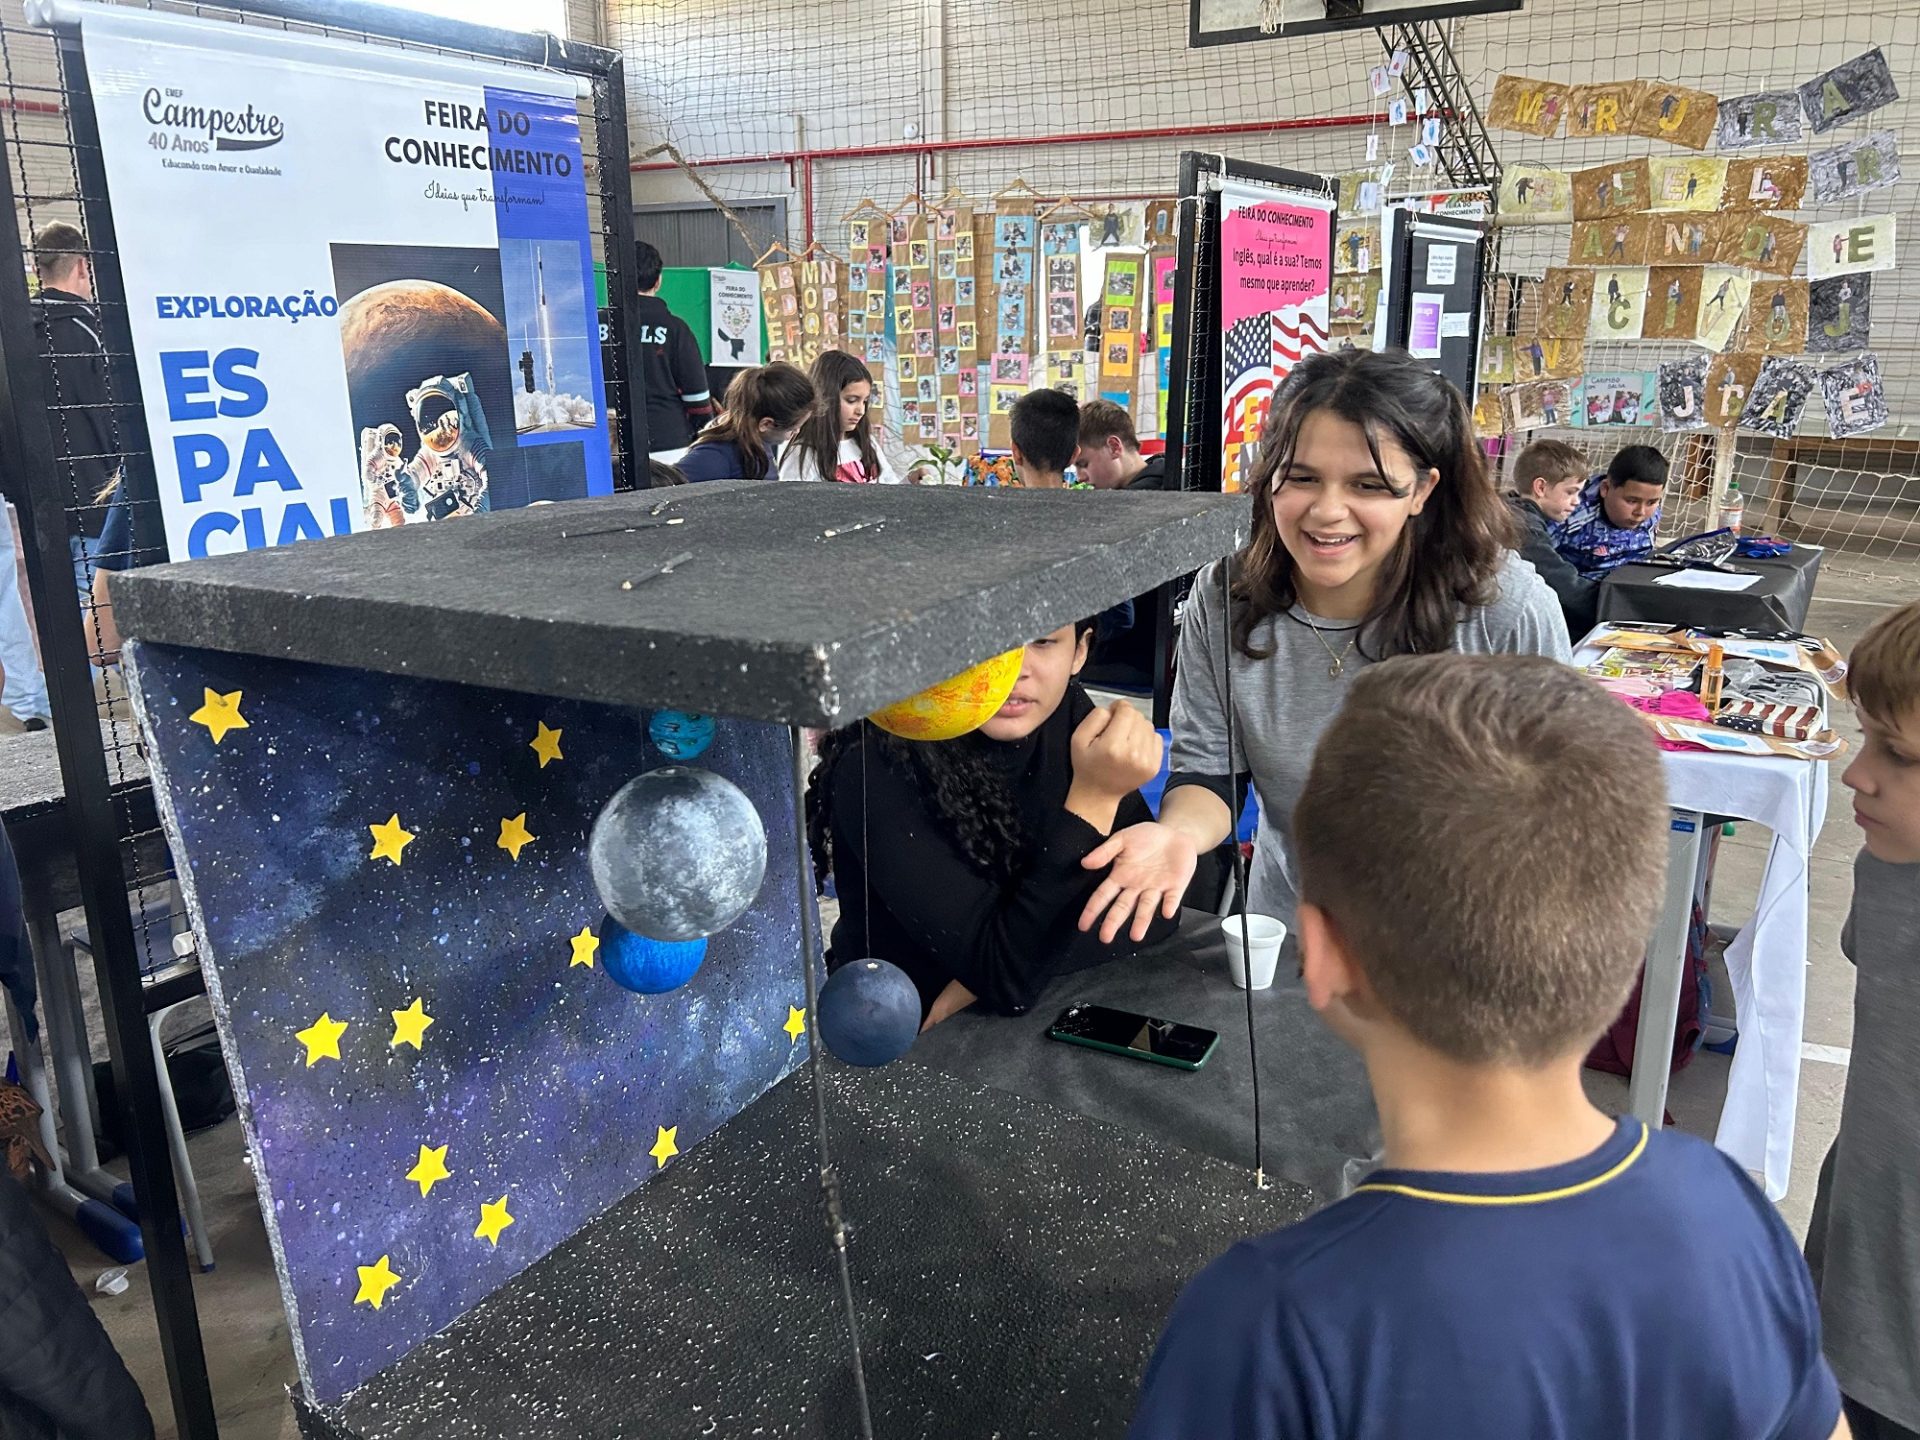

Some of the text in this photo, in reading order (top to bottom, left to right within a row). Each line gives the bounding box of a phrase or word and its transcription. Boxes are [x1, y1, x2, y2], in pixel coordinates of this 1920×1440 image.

[165, 88, 183, 98] EMEF
[1514, 79, 1851, 138] M R J R A
[143, 87, 284, 141] Campestre
[424, 99, 531, 137] FEIRA DO
[148, 131, 209, 154] 40 Anos
[385, 136, 572, 178] CONHECIMENTO
[162, 158, 200, 171] Educando
[201, 163, 217, 172] com
[218, 163, 237, 174] Amor
[239, 166, 244, 174] e
[1660, 165, 1688, 201] E
[1748, 167, 1775, 200] L
[1854, 147, 1883, 186] R
[424, 180, 545, 213] Ideias que transformam!
[1238, 205, 1314, 229] FEIRA DO CONHECIMENTO
[1233, 247, 1322, 270] Inglês, qual é a sua? Temos
[1581, 225, 1604, 258] A
[1663, 223, 1691, 257] N
[1847, 225, 1876, 264] E
[762, 266, 795, 292] A B
[802, 260, 837, 285] M N
[1240, 276, 1315, 295] mesmo que aprender?
[156, 289, 338, 324] EXPLORAÇÃO
[764, 294, 797, 319] C D
[804, 286, 838, 311] O P
[767, 321, 785, 347] E
[785, 320, 801, 346] F
[804, 311, 839, 336] Q R
[1607, 298, 1632, 331] C
[1664, 298, 1677, 329] I
[1823, 303, 1850, 338] J
[803, 340, 819, 365] S
[1482, 338, 1561, 375] H V
[159, 347, 269, 422] ES
[1509, 389, 1549, 429] L
[1673, 385, 1694, 418] J
[1760, 388, 1788, 424] A
[172, 427, 303, 504] PA
